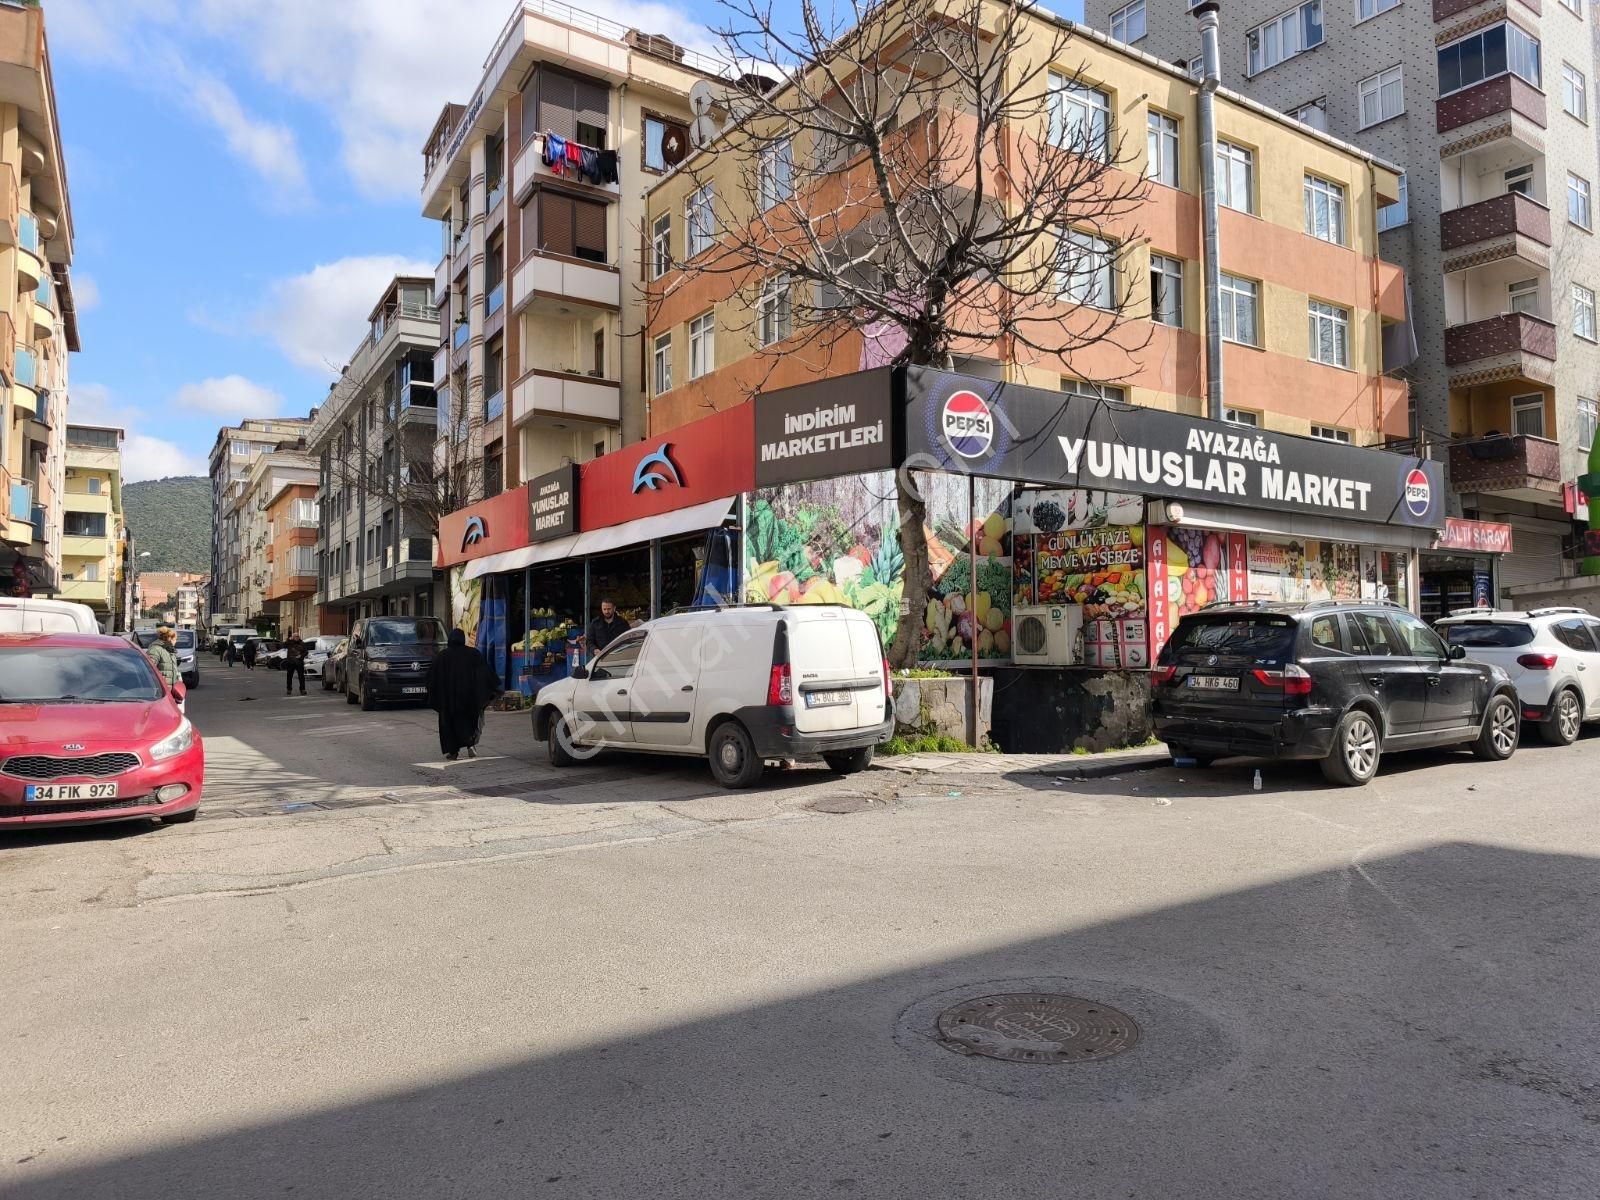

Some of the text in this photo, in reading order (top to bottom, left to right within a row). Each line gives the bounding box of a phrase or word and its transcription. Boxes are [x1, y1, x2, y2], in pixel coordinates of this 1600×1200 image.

[784, 403, 856, 435] İNDİRİM
[945, 414, 990, 434] PEPSI
[761, 419, 883, 462] MARKETLERİ
[1186, 428, 1281, 465] AYAZAĞA
[1057, 435, 1372, 511] YUNUSLAR MARKET
[1406, 486, 1428, 498] PEPSI
[531, 491, 569, 515] YUNUSLAR
[535, 511, 565, 531] MARKET
[1048, 530, 1130, 551] GÜNLÜK TAZE
[1041, 548, 1139, 570] MEYVE VE SEBZE
[1191, 677, 1200, 687] 34
[1223, 679, 1238, 689] 460
[35, 786, 53, 799] 34
[58, 785, 81, 799] FIK
[89, 784, 116, 798] 973
